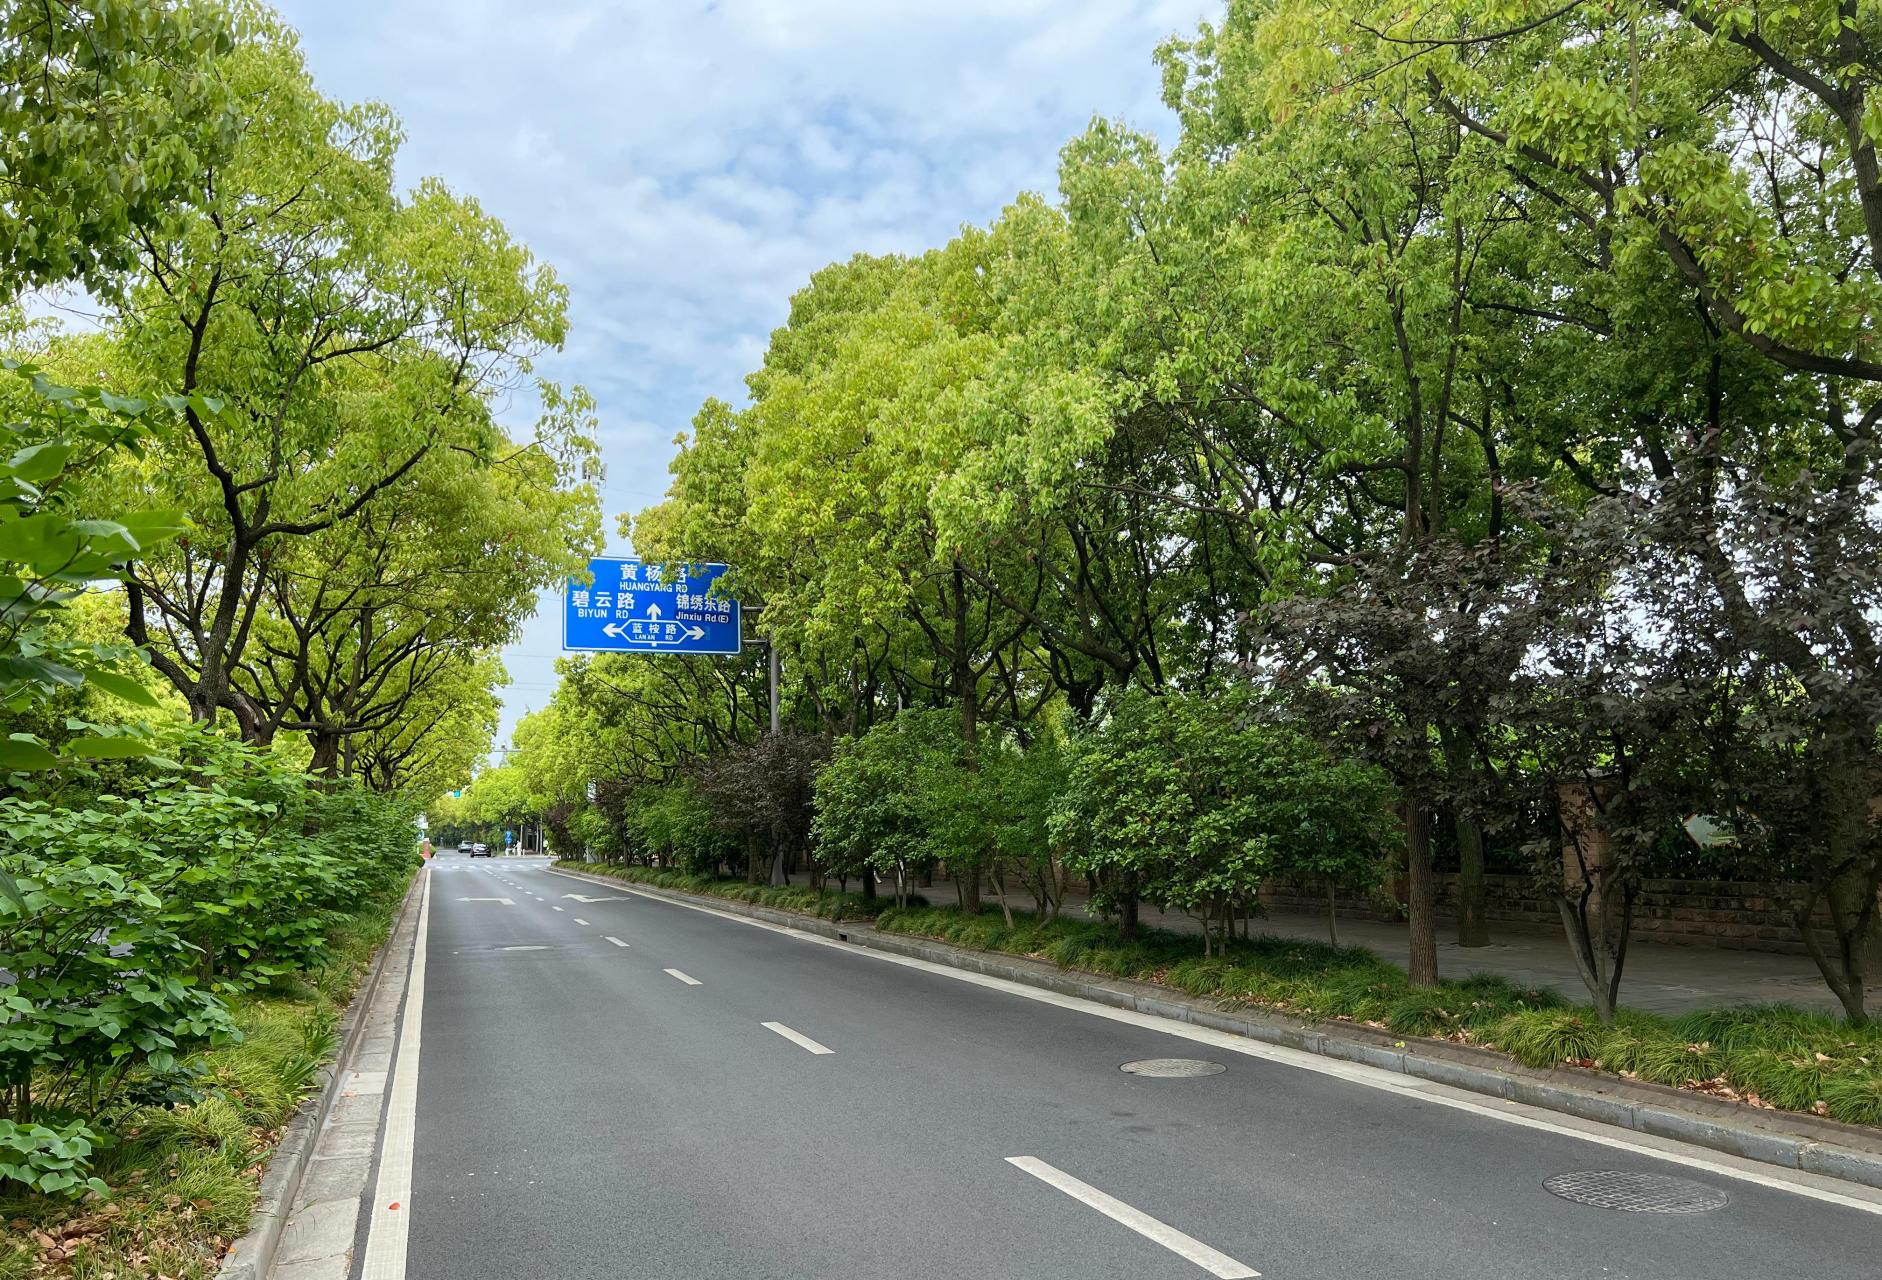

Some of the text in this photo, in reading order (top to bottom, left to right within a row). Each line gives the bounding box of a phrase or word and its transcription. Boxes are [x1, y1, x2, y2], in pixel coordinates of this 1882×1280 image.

[619, 581, 688, 593] HUANGYANG RD
[572, 590, 635, 610] 碧云路
[676, 593, 731, 613] 锦绣东路
[578, 608, 629, 619] BIYUN RD
[675, 611, 702, 621] Jinxiu
[632, 622, 676, 635] 蓝桉路
